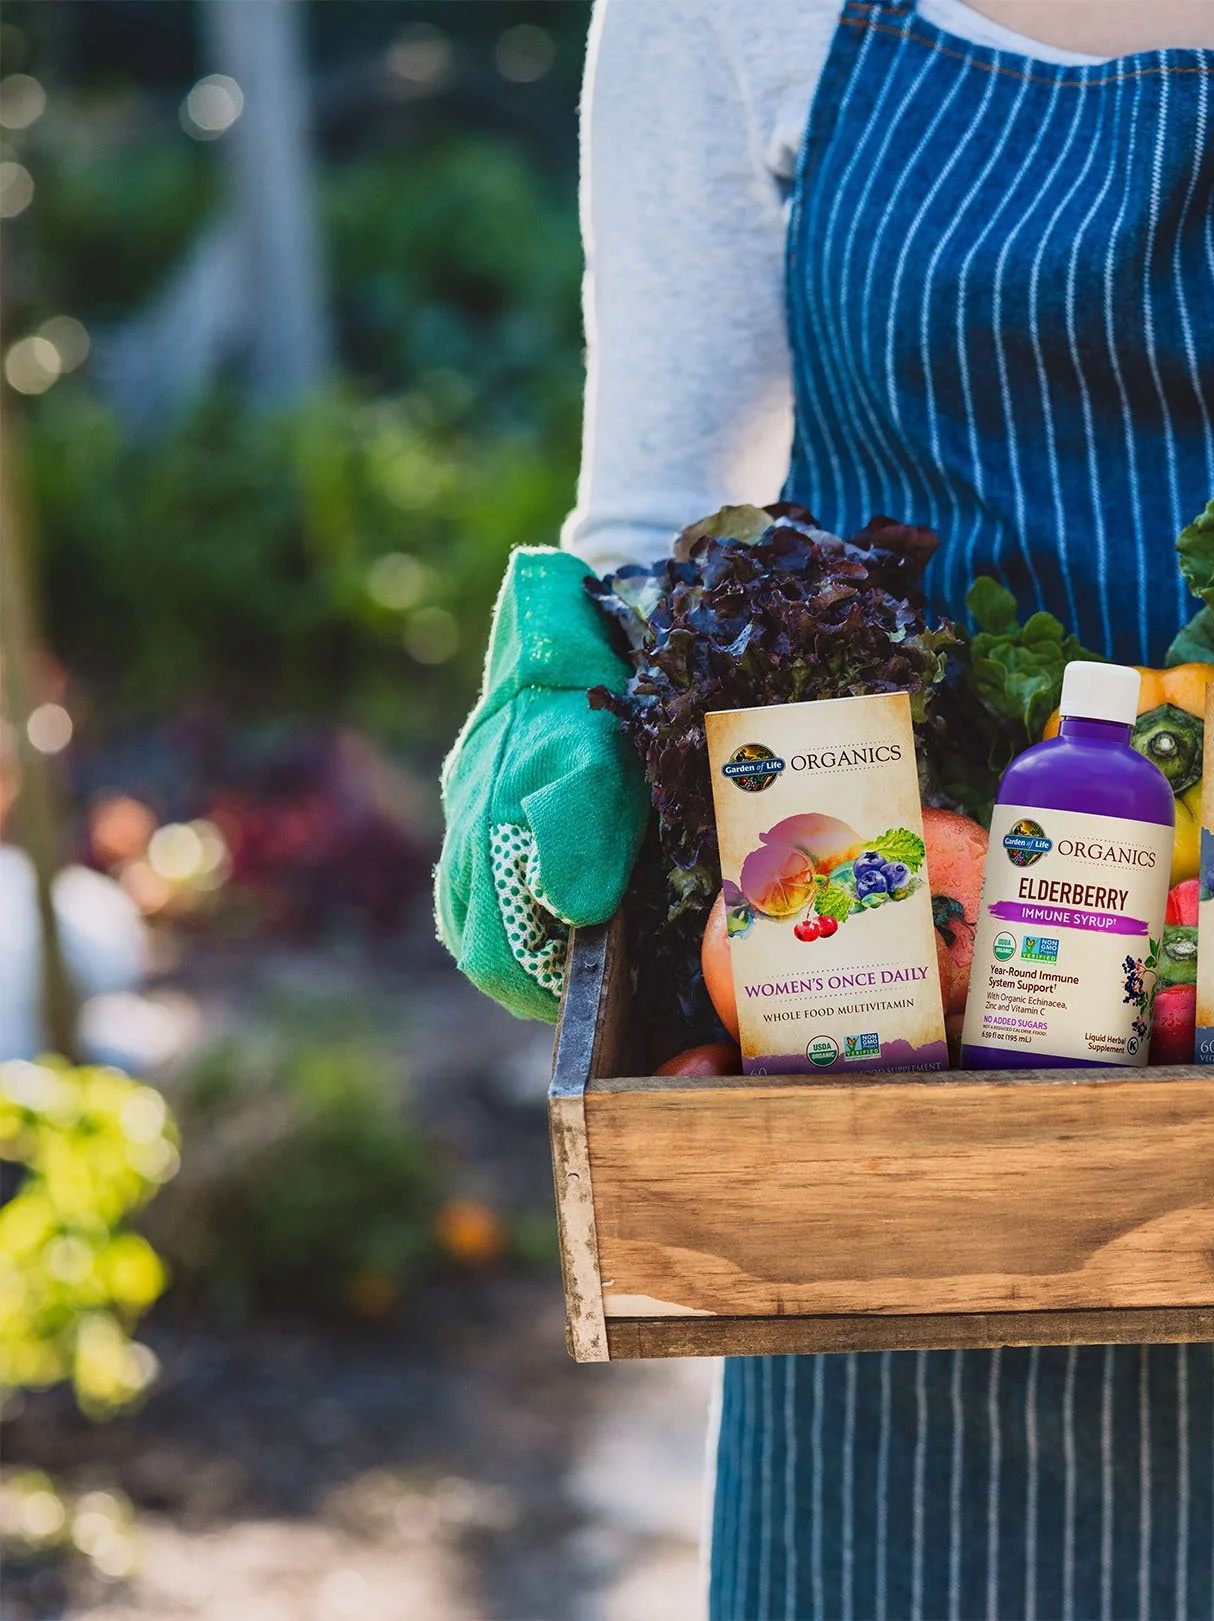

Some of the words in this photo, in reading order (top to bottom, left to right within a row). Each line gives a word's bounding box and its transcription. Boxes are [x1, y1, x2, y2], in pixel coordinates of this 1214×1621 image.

[791, 745, 902, 771] ORGANICS
[725, 763, 755, 774] Garden
[756, 762, 766, 772] of
[766, 760, 782, 770] Life
[1005, 837, 1026, 846] Garden
[1027, 839, 1034, 848] of
[1036, 840, 1050, 848] Life
[1058, 840, 1156, 868] ORGANICS
[1018, 877, 1128, 911] ELDERBERRY
[1022, 908, 1070, 923] IMMUNE
[1022, 952, 1056, 960] VERIFIED
[990, 964, 1037, 979] Year-Round
[1040, 970, 1080, 984] Immune
[744, 977, 824, 999] WOMEN'S
[828, 972, 876, 990] ONCE
[881, 966, 929, 985] DAILY
[988, 976, 1016, 988] System
[986, 992, 1000, 1000] With
[1000, 993, 1026, 1004] Organic
[1028, 996, 1068, 1010] Echinacea,
[763, 1010, 801, 1023] WHOLE
[804, 1007, 834, 1019] FOOD
[837, 998, 915, 1015] MULTIVITAMIN
[986, 1001, 996, 1010] Zinc
[998, 1002, 1010, 1011] and
[1011, 1004, 1038, 1015] Vitamin
[1040, 1008, 1046, 1016] C
[993, 1016, 1016, 1026] ADDED
[1018, 1020, 1048, 1030] SUGARS
[1005, 1034, 1018, 1042] (195
[1084, 1032, 1106, 1042] Liquid
[1107, 1036, 1126, 1044] Herbal
[812, 1042, 832, 1051] USDA
[1088, 1042, 1125, 1054] Supplement
